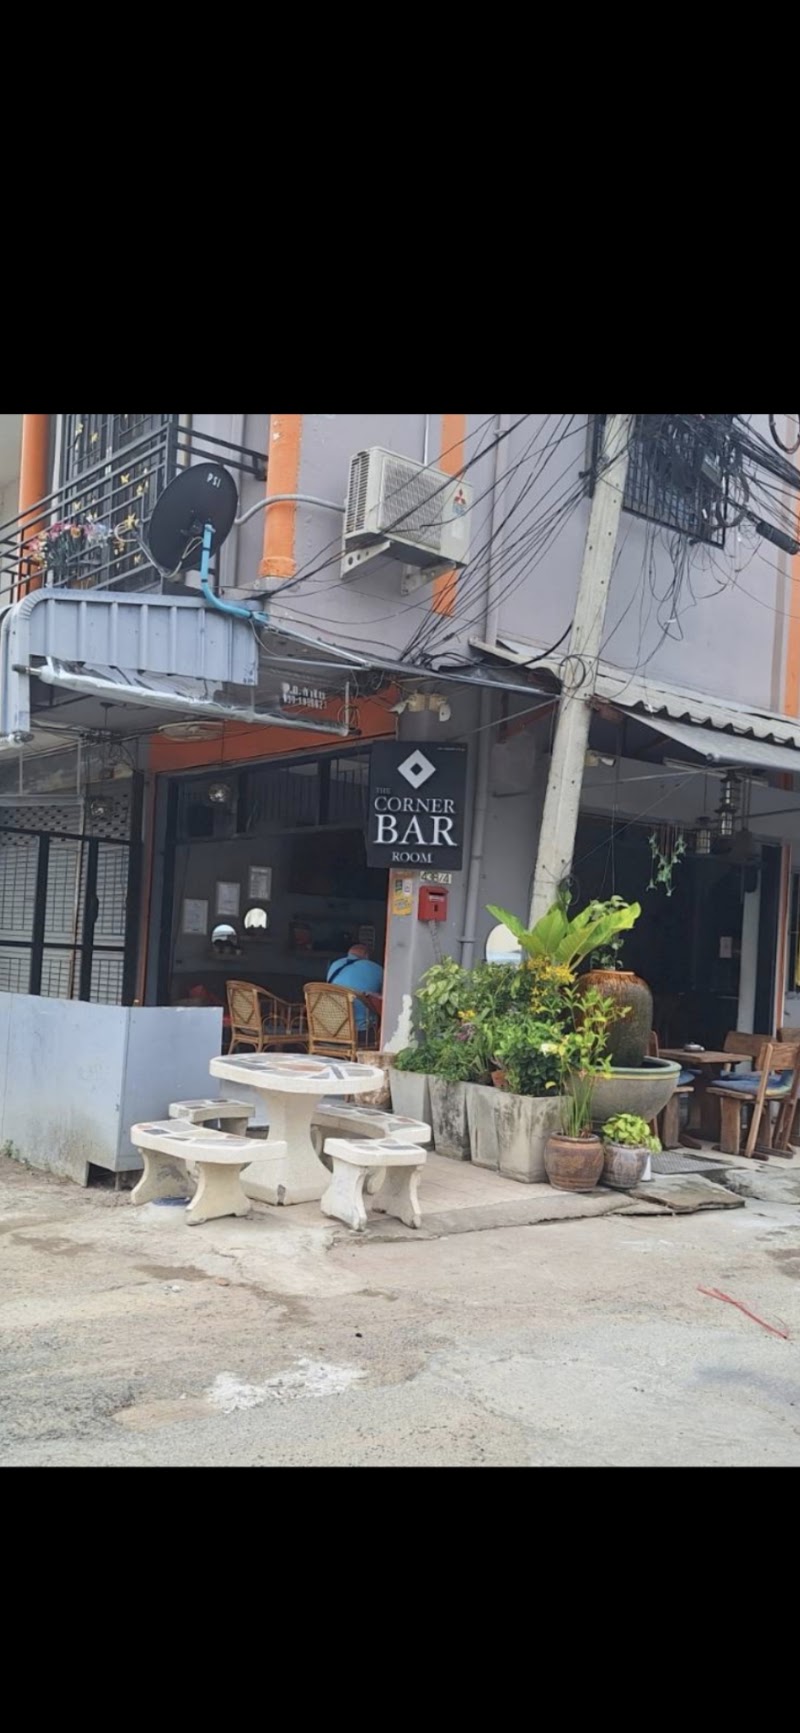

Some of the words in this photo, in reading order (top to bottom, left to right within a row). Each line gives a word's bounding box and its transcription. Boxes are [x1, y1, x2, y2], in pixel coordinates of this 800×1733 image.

[207, 472, 221, 488] PSI
[376, 787, 391, 795] THE
[374, 796, 455, 813] CORNER
[373, 813, 458, 846] BAR
[392, 851, 432, 863] ROOM
